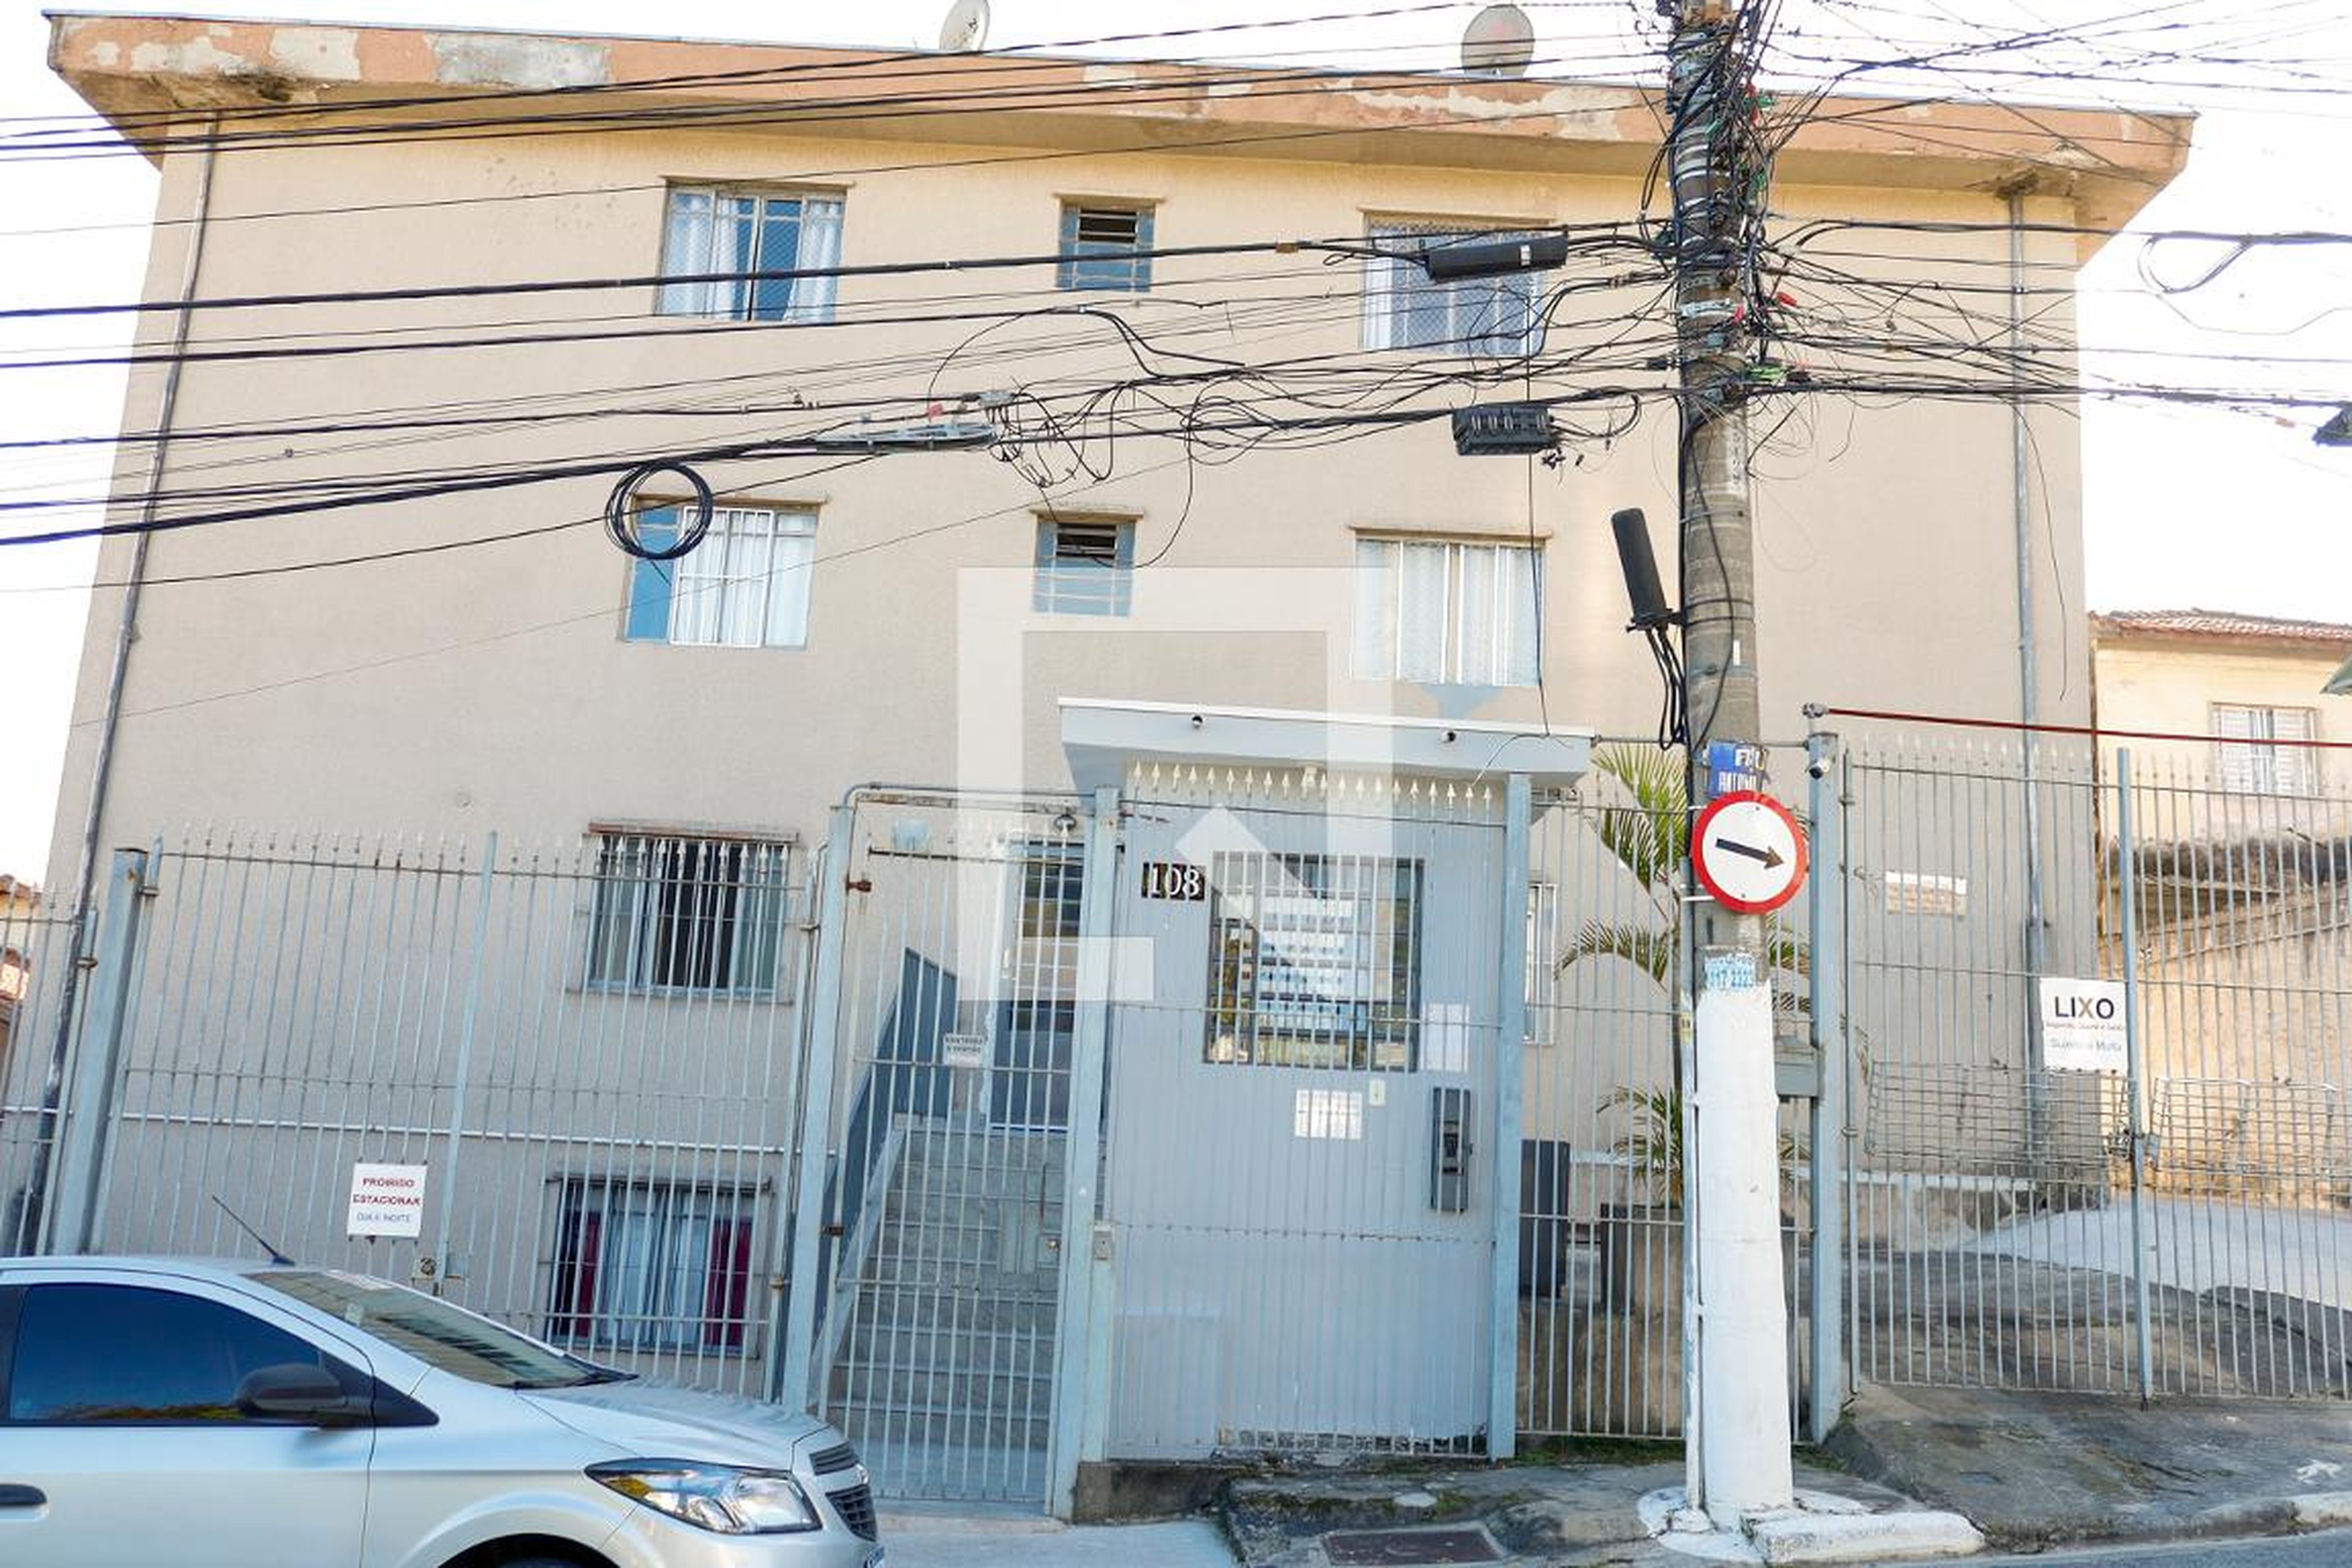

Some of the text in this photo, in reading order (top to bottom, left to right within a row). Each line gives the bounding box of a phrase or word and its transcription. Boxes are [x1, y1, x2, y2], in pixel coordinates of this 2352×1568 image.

[1151, 866, 1200, 897] 108
[2054, 996, 2114, 1019] LIXO
[363, 1177, 415, 1188] PROIBIDO
[352, 1194, 421, 1207] ESTACIONAR
